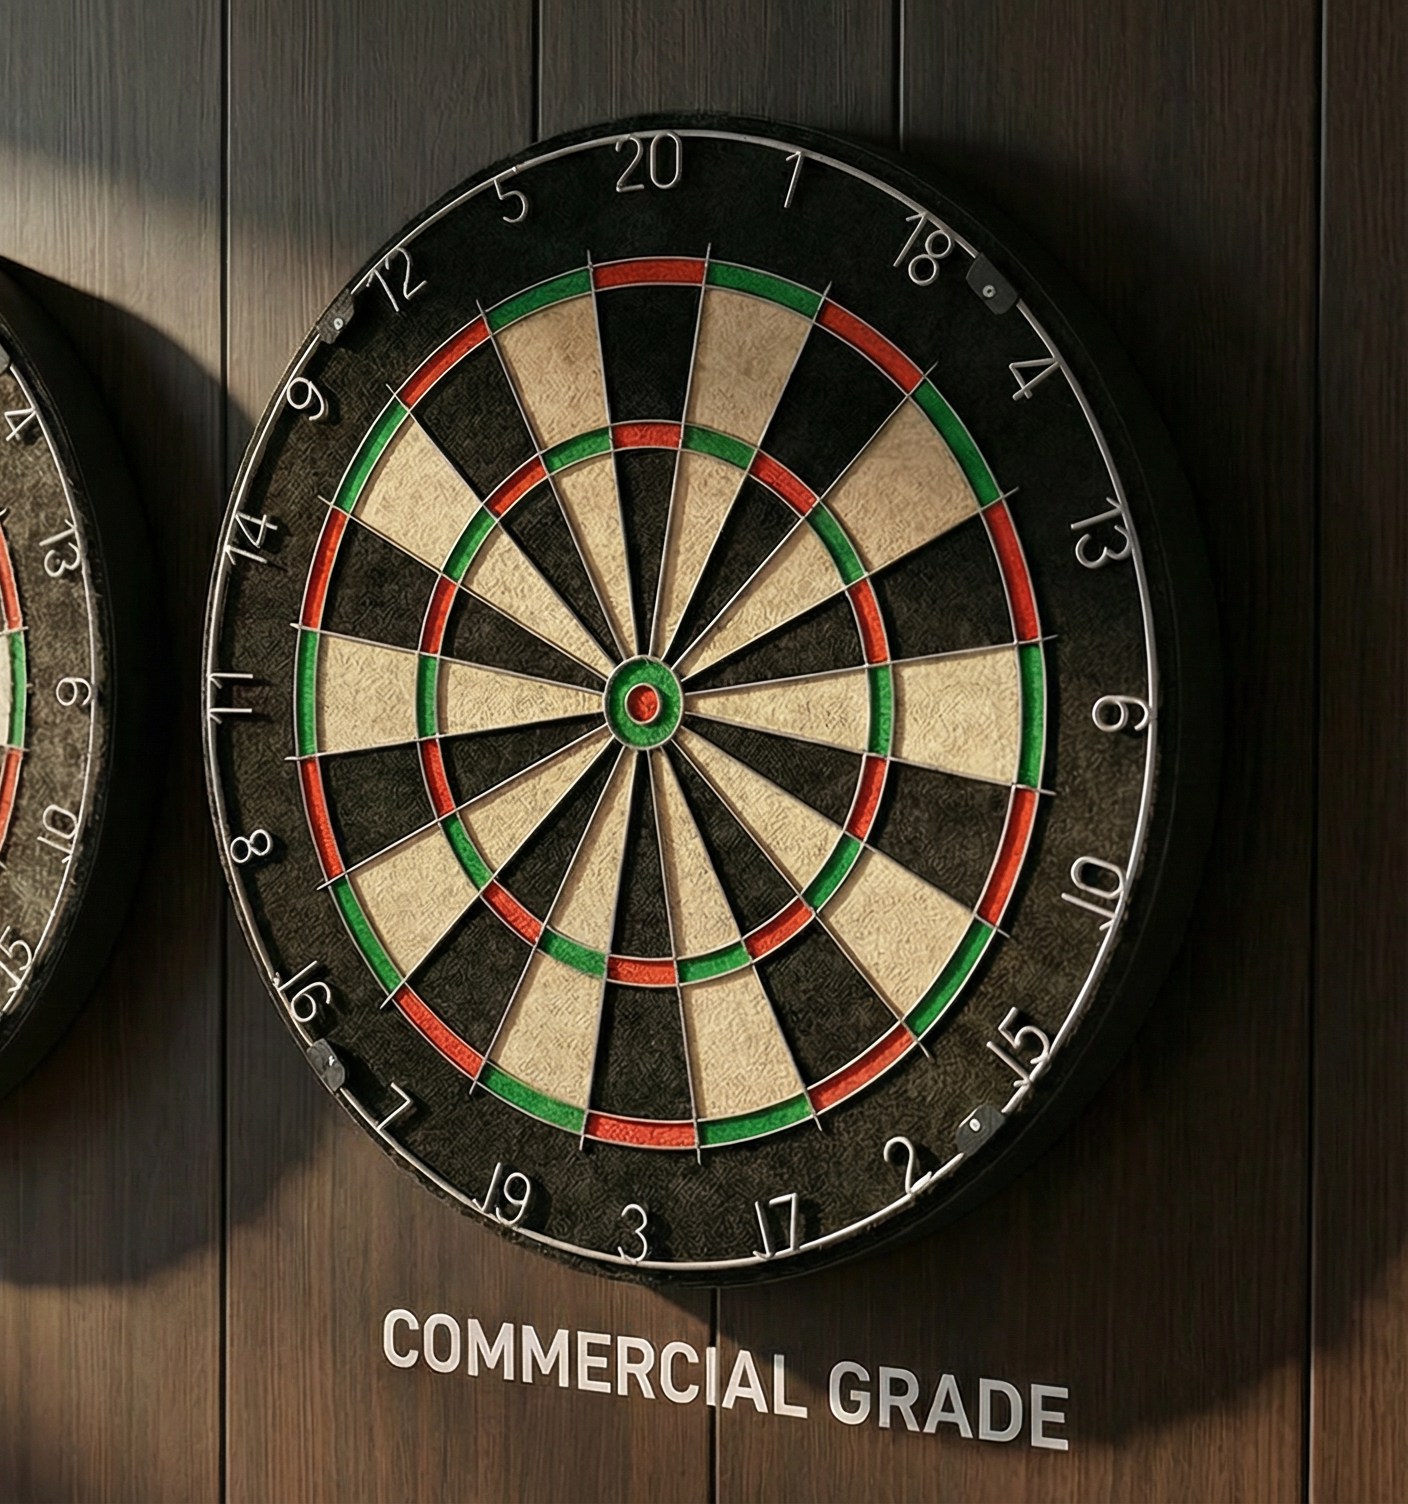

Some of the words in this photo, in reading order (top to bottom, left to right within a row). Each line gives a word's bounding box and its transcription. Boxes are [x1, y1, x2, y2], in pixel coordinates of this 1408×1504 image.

[614, 131, 684, 192] 20
[785, 150, 804, 208] 1
[494, 178, 529, 223] 5
[893, 211, 954, 287] 18
[365, 247, 428, 313] 12
[285, 376, 329, 422] 9
[1008, 357, 1060, 401] 4
[2, 405, 37, 442] 4
[39, 519, 84, 579] 13
[223, 508, 278, 570] 14
[1069, 496, 1132, 570] 13
[206, 672, 254, 725] 11
[36, 803, 80, 863] 10
[228, 828, 274, 864] 8
[1060, 855, 1127, 932] 10
[273, 959, 332, 1024] 16
[985, 1006, 1052, 1090] 15
[376, 1082, 412, 1133] 7
[472, 1161, 531, 1226] 19
[883, 1136, 933, 1197] 2
[616, 1203, 649, 1264] 3
[752, 1192, 797, 1262] 17
[382, 1308, 809, 1420] COMMERCIAL
[828, 1360, 1071, 1452] GRADE
